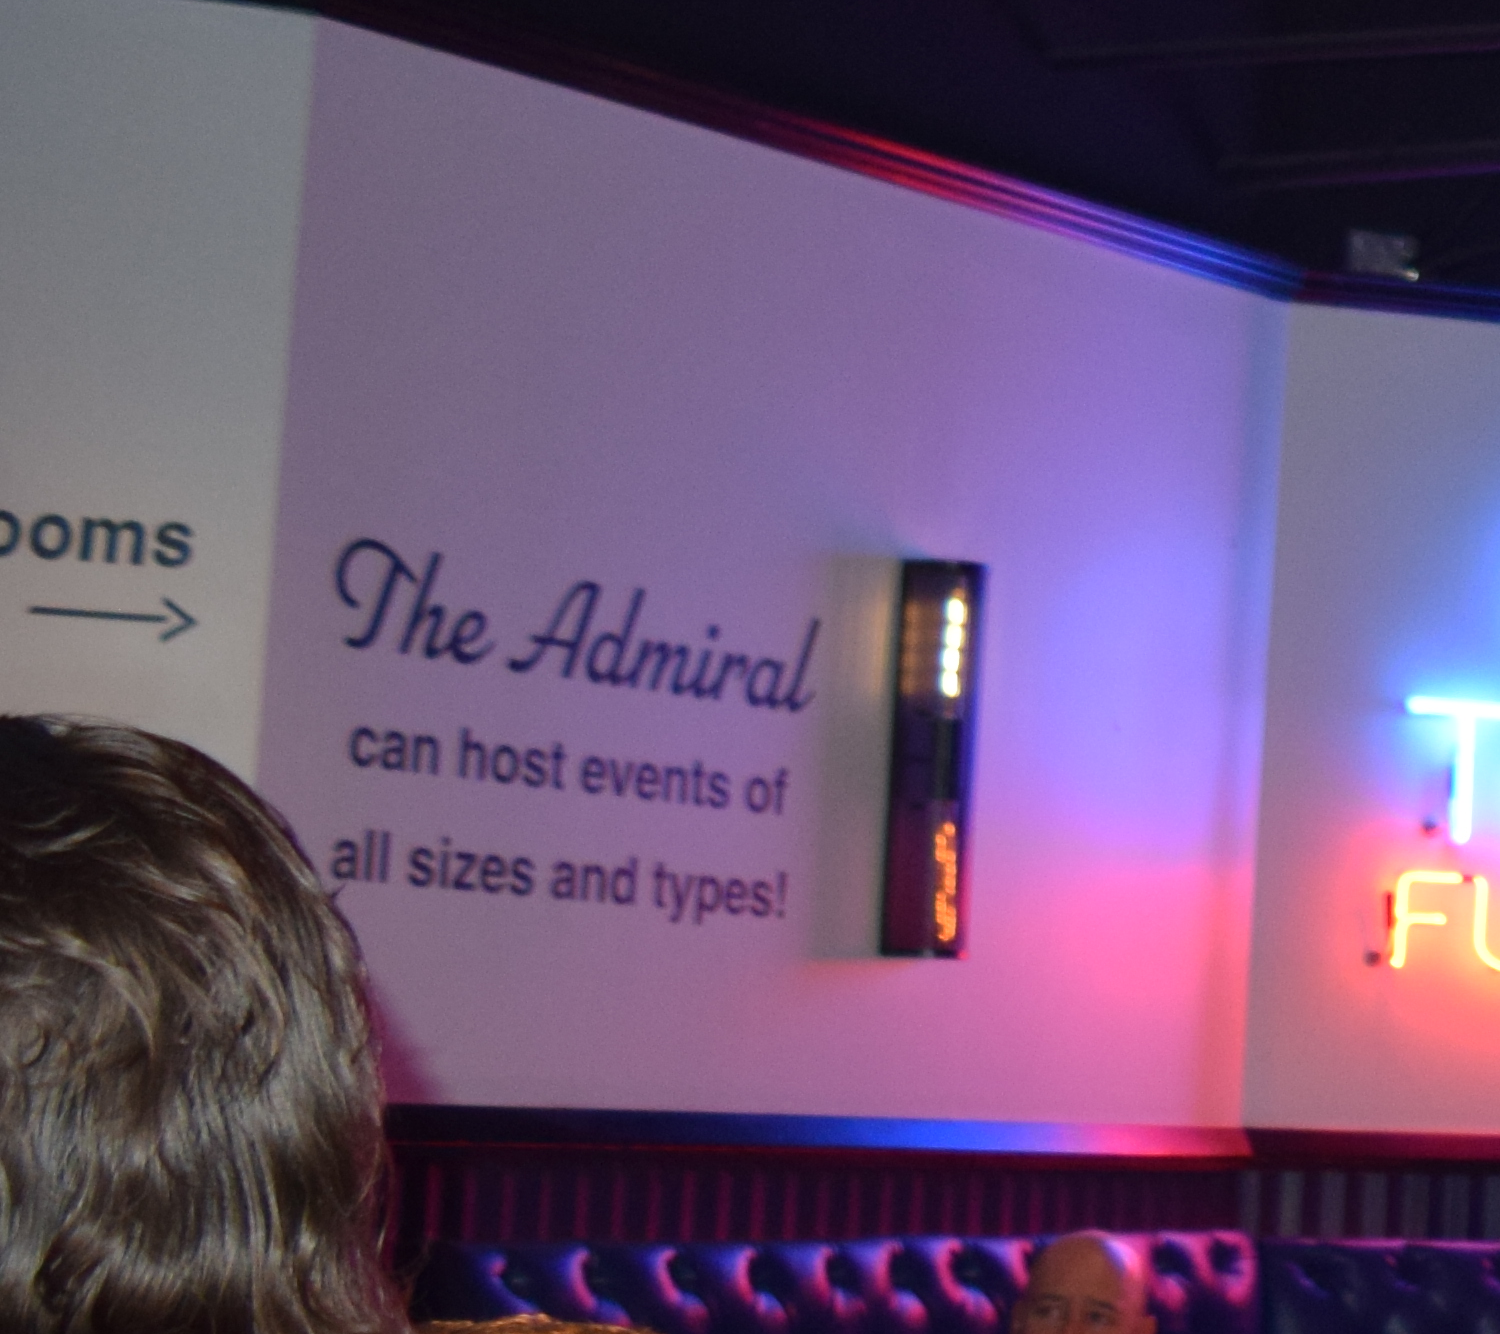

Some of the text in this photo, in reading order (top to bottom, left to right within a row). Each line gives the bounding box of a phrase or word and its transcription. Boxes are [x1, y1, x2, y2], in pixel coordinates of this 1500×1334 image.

[333, 539, 821, 713] The Admiral
[350, 723, 789, 816] can host events of
[331, 831, 788, 925] all sizes and types!
